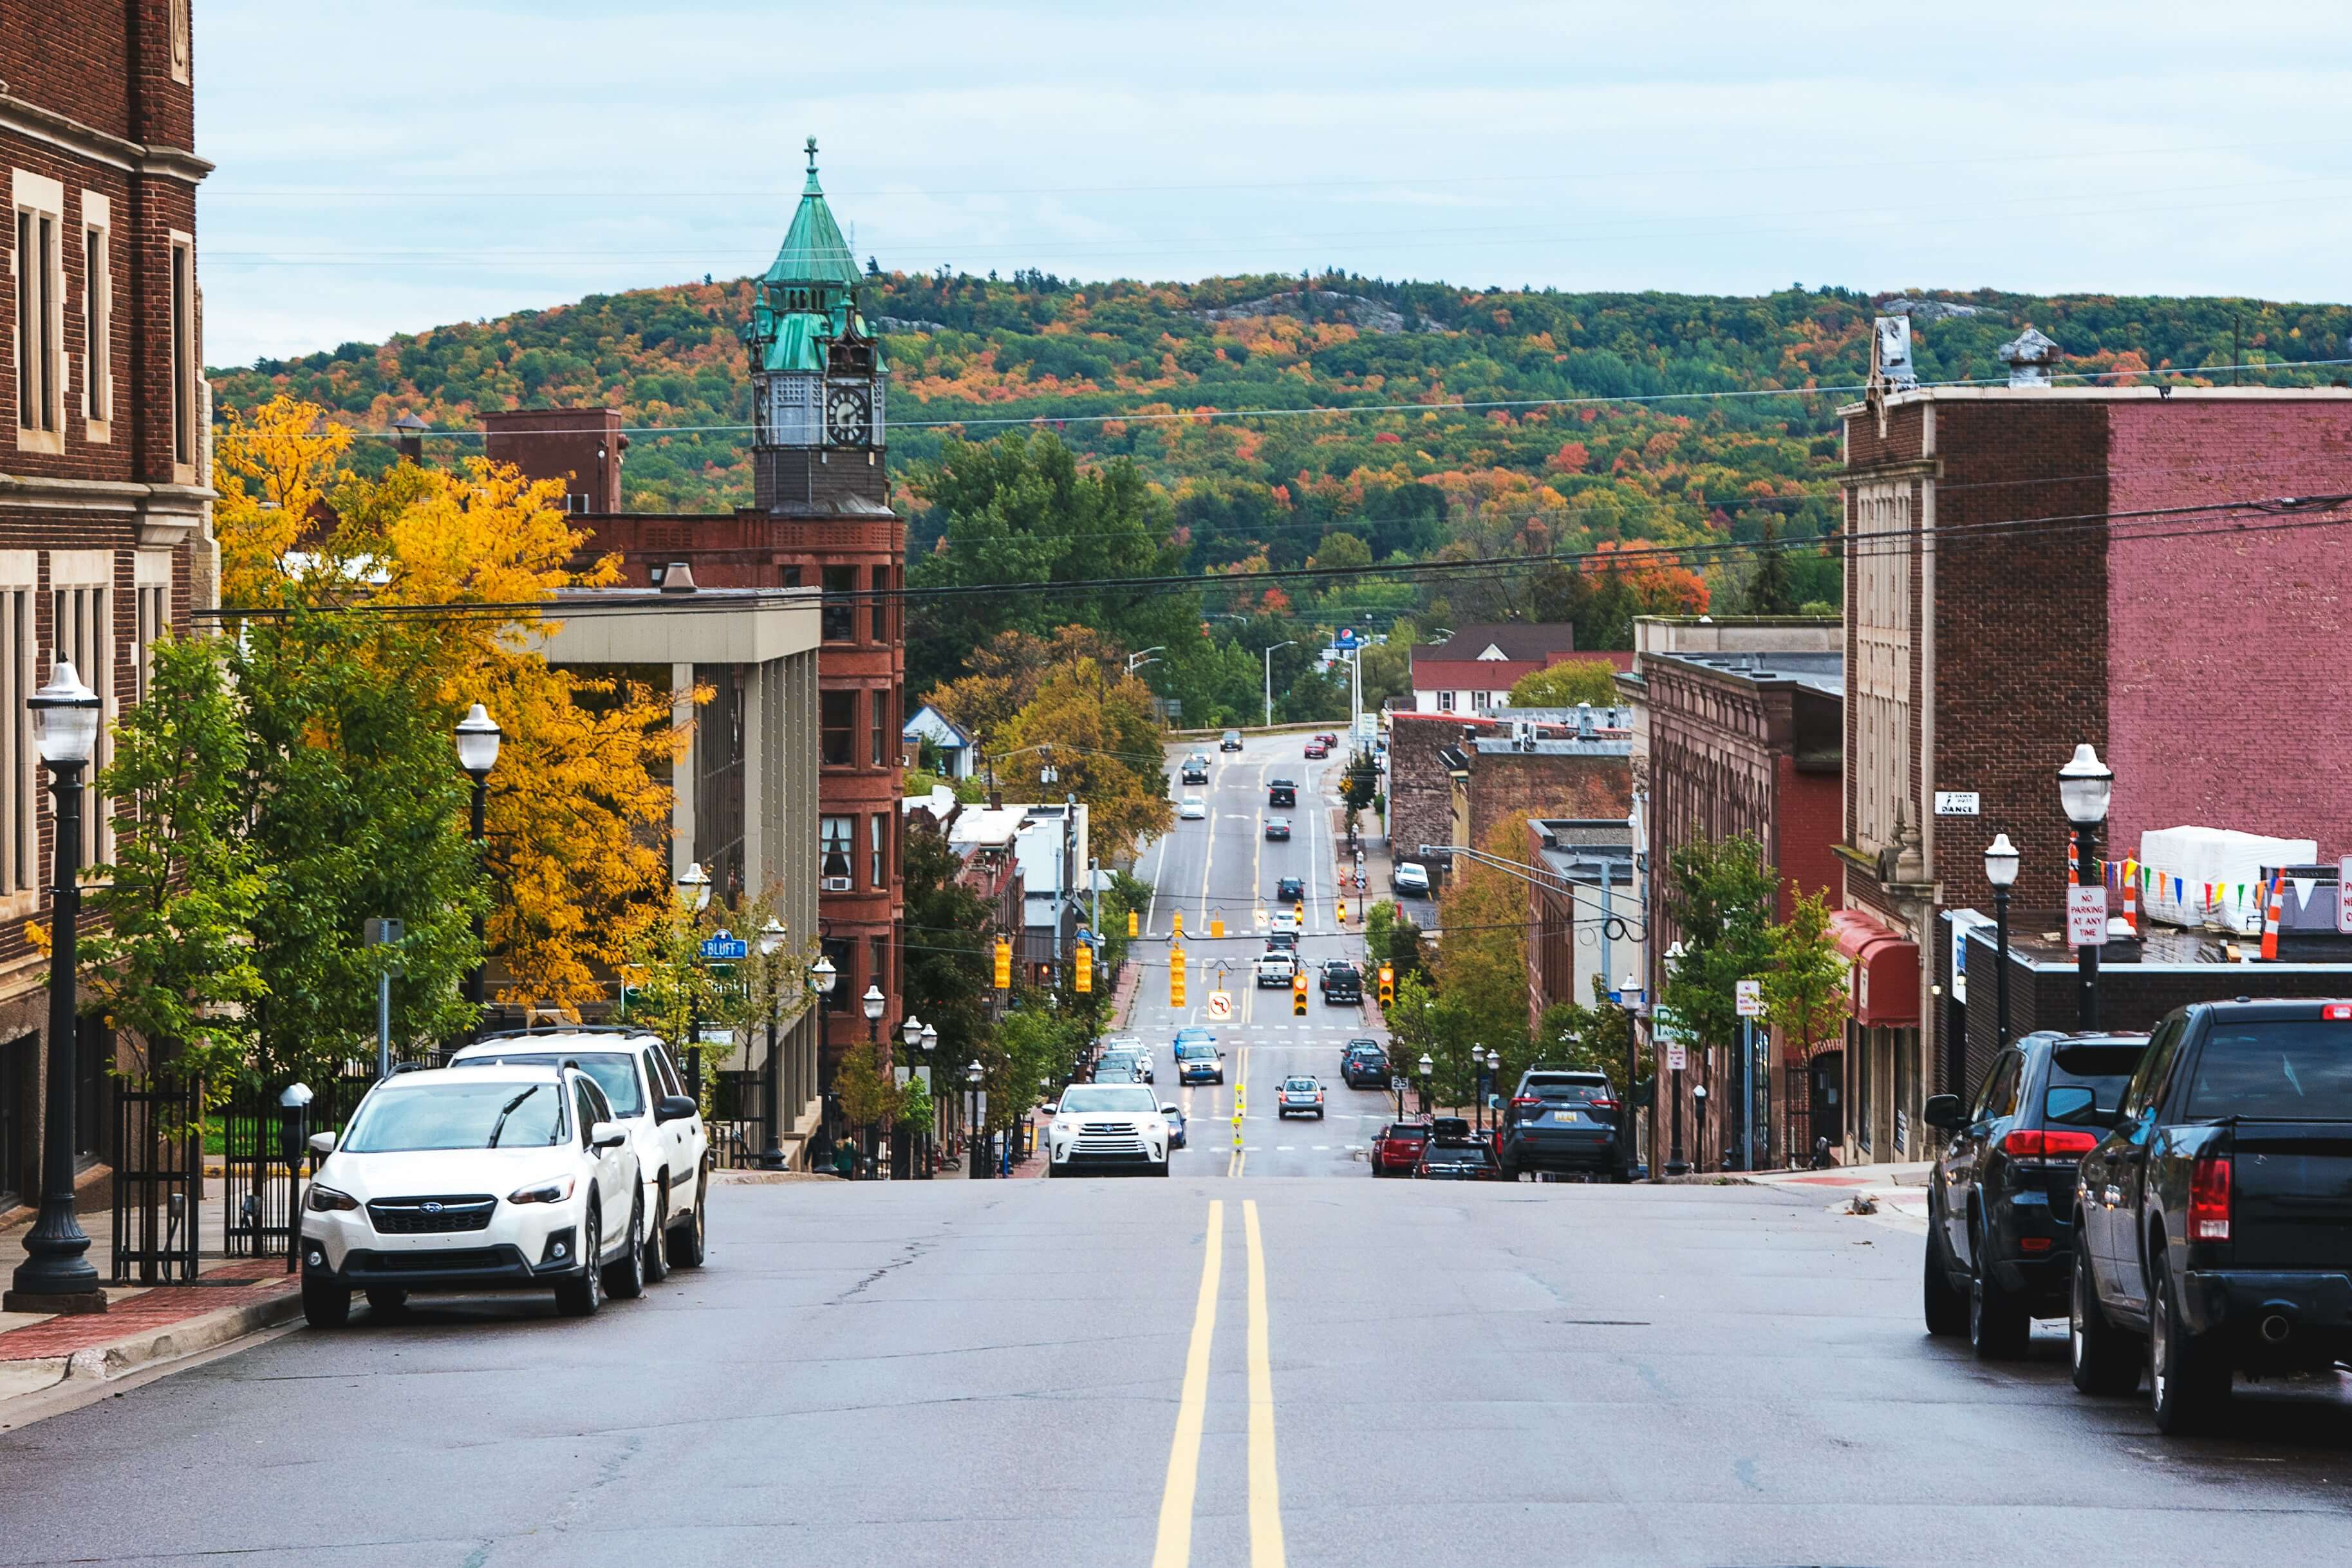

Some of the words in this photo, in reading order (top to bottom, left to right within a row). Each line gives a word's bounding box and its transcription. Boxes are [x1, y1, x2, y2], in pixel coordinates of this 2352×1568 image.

[2073, 917, 2081, 926] AT
[2086, 917, 2101, 926] ANY
[2080, 928, 2096, 937] TIME
[707, 942, 736, 955] BLUFF
[1393, 1079, 1408, 1087] 25
